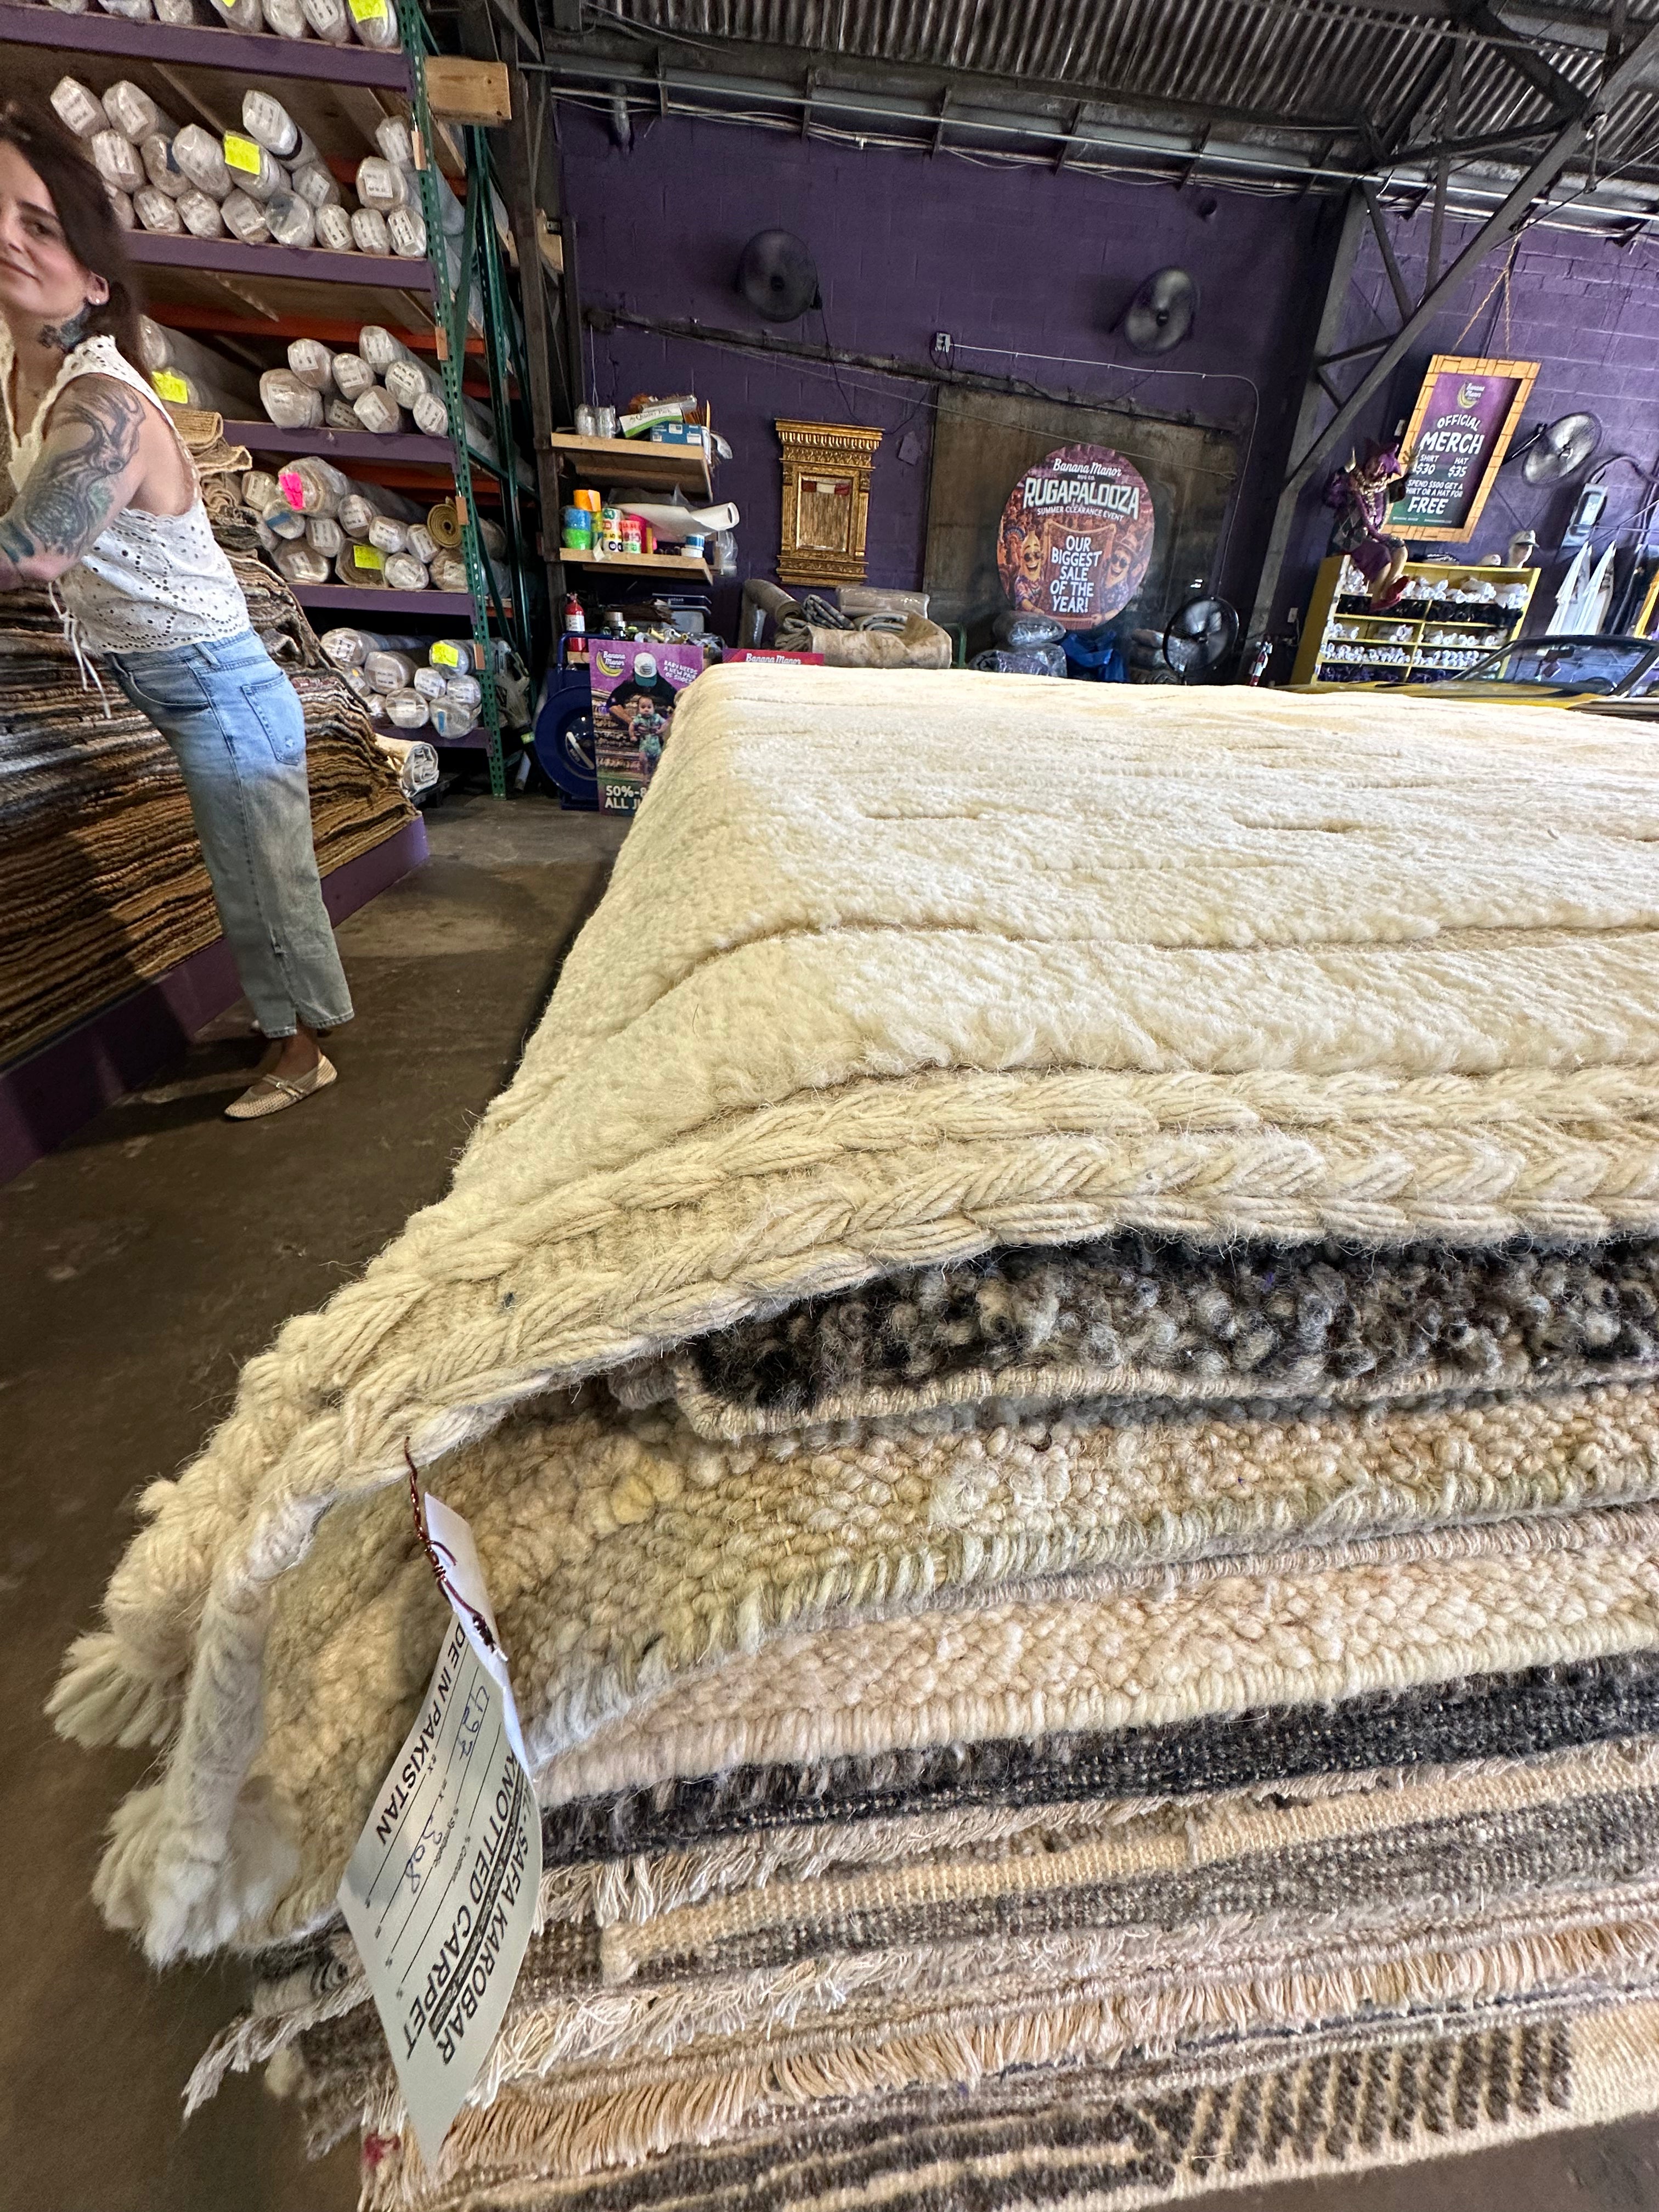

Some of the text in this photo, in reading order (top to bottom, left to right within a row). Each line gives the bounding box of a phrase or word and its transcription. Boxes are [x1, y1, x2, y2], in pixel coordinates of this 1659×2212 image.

[1437, 414, 1481, 432] OFFICIAL
[1419, 431, 1485, 454] MERCH
[1420, 454, 1440, 462] SHIRT
[1454, 457, 1469, 465] HAT
[1053, 458, 1122, 477] Banana Manor
[1416, 462, 1436, 475] $30
[1448, 465, 1468, 478] $35
[1407, 479, 1429, 488] SPEND
[1428, 481, 1444, 489] $500
[1023, 477, 1139, 520] RUGAPALOOZA
[1407, 496, 1449, 515] FREE
[1037, 506, 1124, 521] SUMMER CLEARANCE EVENT
[1065, 535, 1092, 552] OUR
[1051, 546, 1102, 567] BIGGEST
[1059, 567, 1089, 580] SALE
[1050, 580, 1094, 597] OF THE
[1053, 596, 1089, 613] YEAR!
[746, 653, 801, 664] Banana Manor
[606, 785, 647, 798] 50%-8
[605, 797, 629, 809] ALL
[437, 1668, 452, 1703] IN
[376, 1704, 441, 1845] PAKISTAN
[405, 1814, 443, 1895] 308
[501, 1827, 529, 1906] SAFA
[403, 1904, 472, 2061] CARPET
[437, 1903, 509, 2066] KAROBAR
